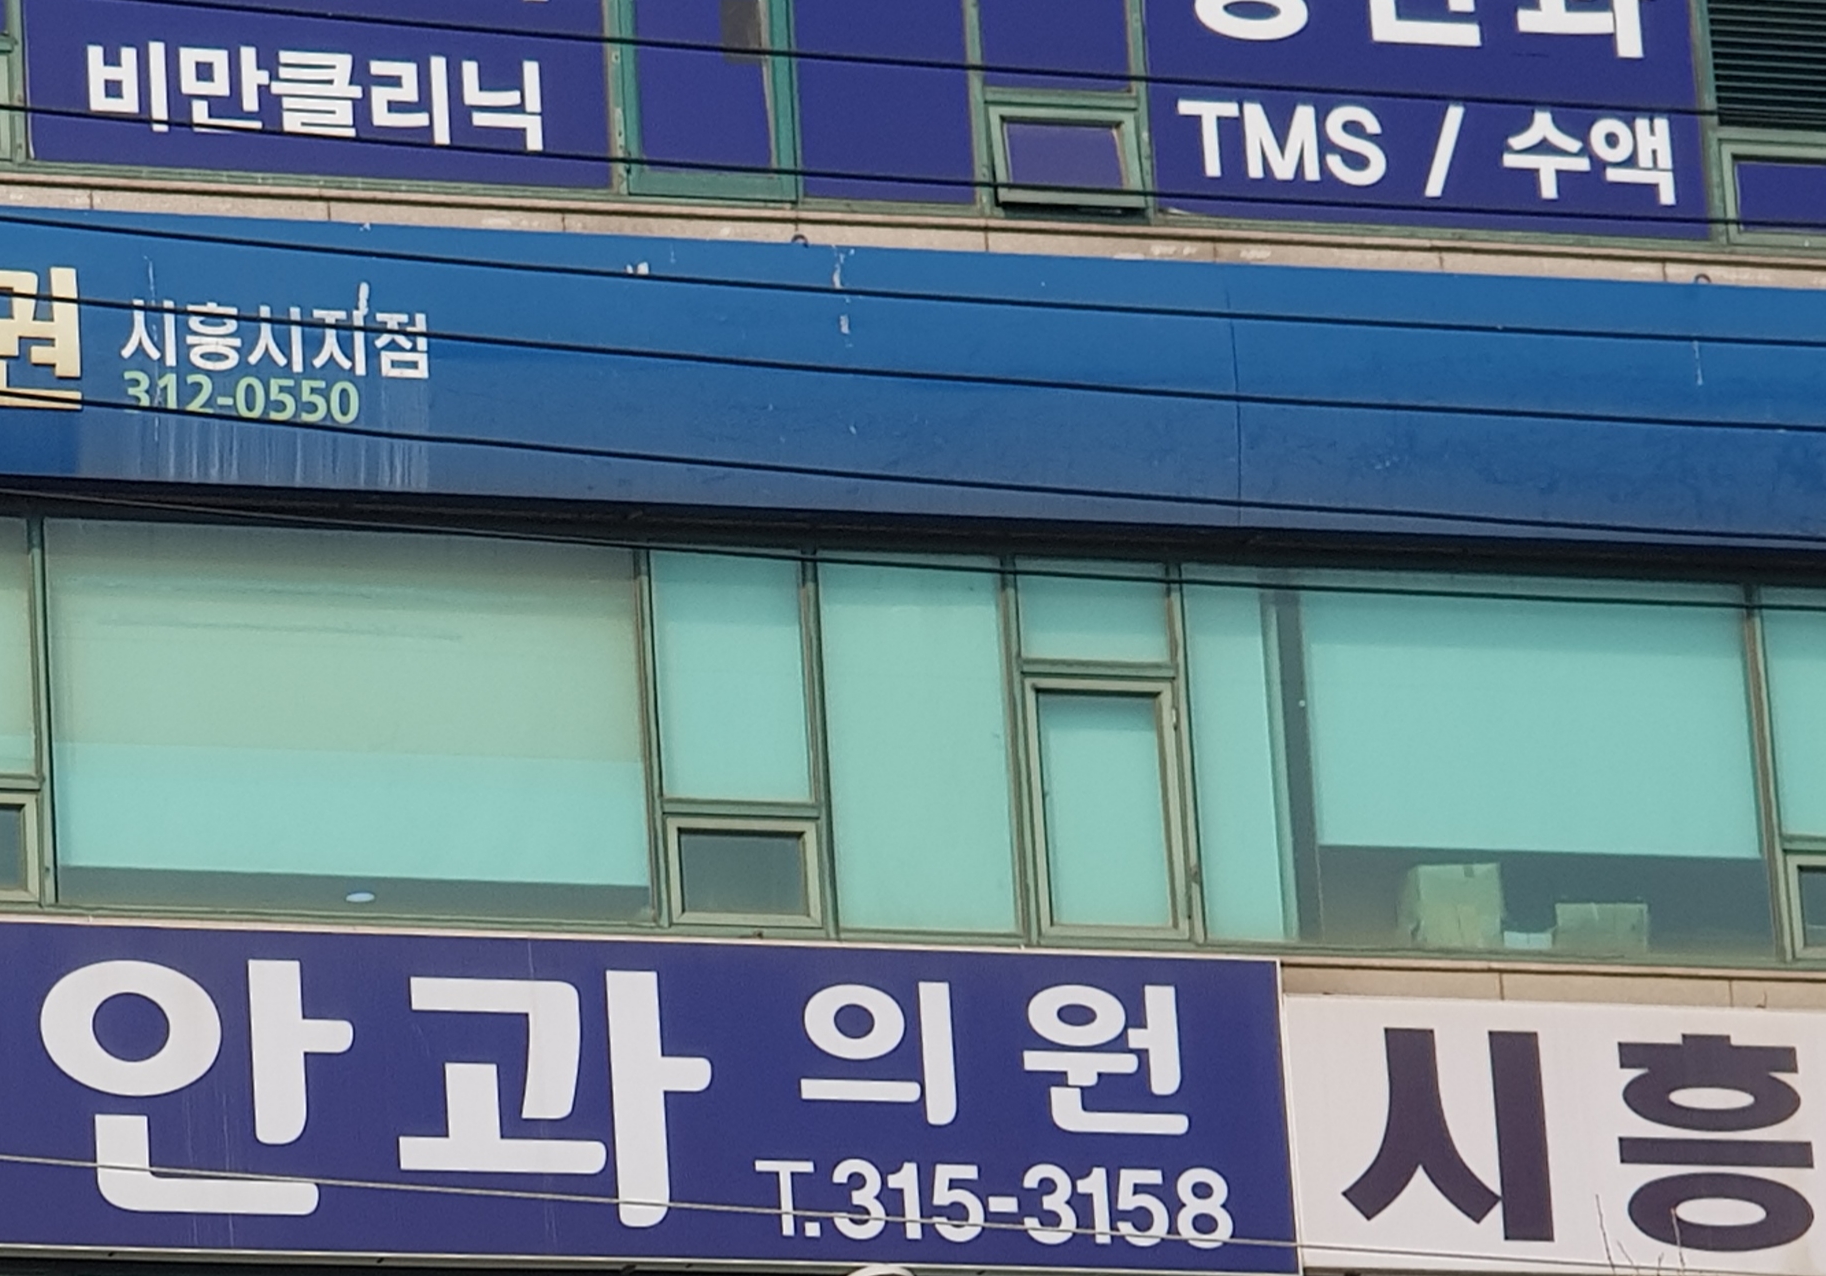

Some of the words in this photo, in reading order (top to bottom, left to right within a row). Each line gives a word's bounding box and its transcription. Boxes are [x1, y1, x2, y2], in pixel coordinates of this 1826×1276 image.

[86, 41, 544, 151] 비만클리닉
[1177, 99, 1386, 187] TMS
[1502, 108, 1676, 206] 수액
[121, 298, 430, 379] 시흥시지점
[123, 370, 360, 424] 312-0550
[799, 981, 1189, 1137] 의원
[1342, 1026, 1815, 1252] 시흥
[754, 1159, 1234, 1248] T.315-3158
